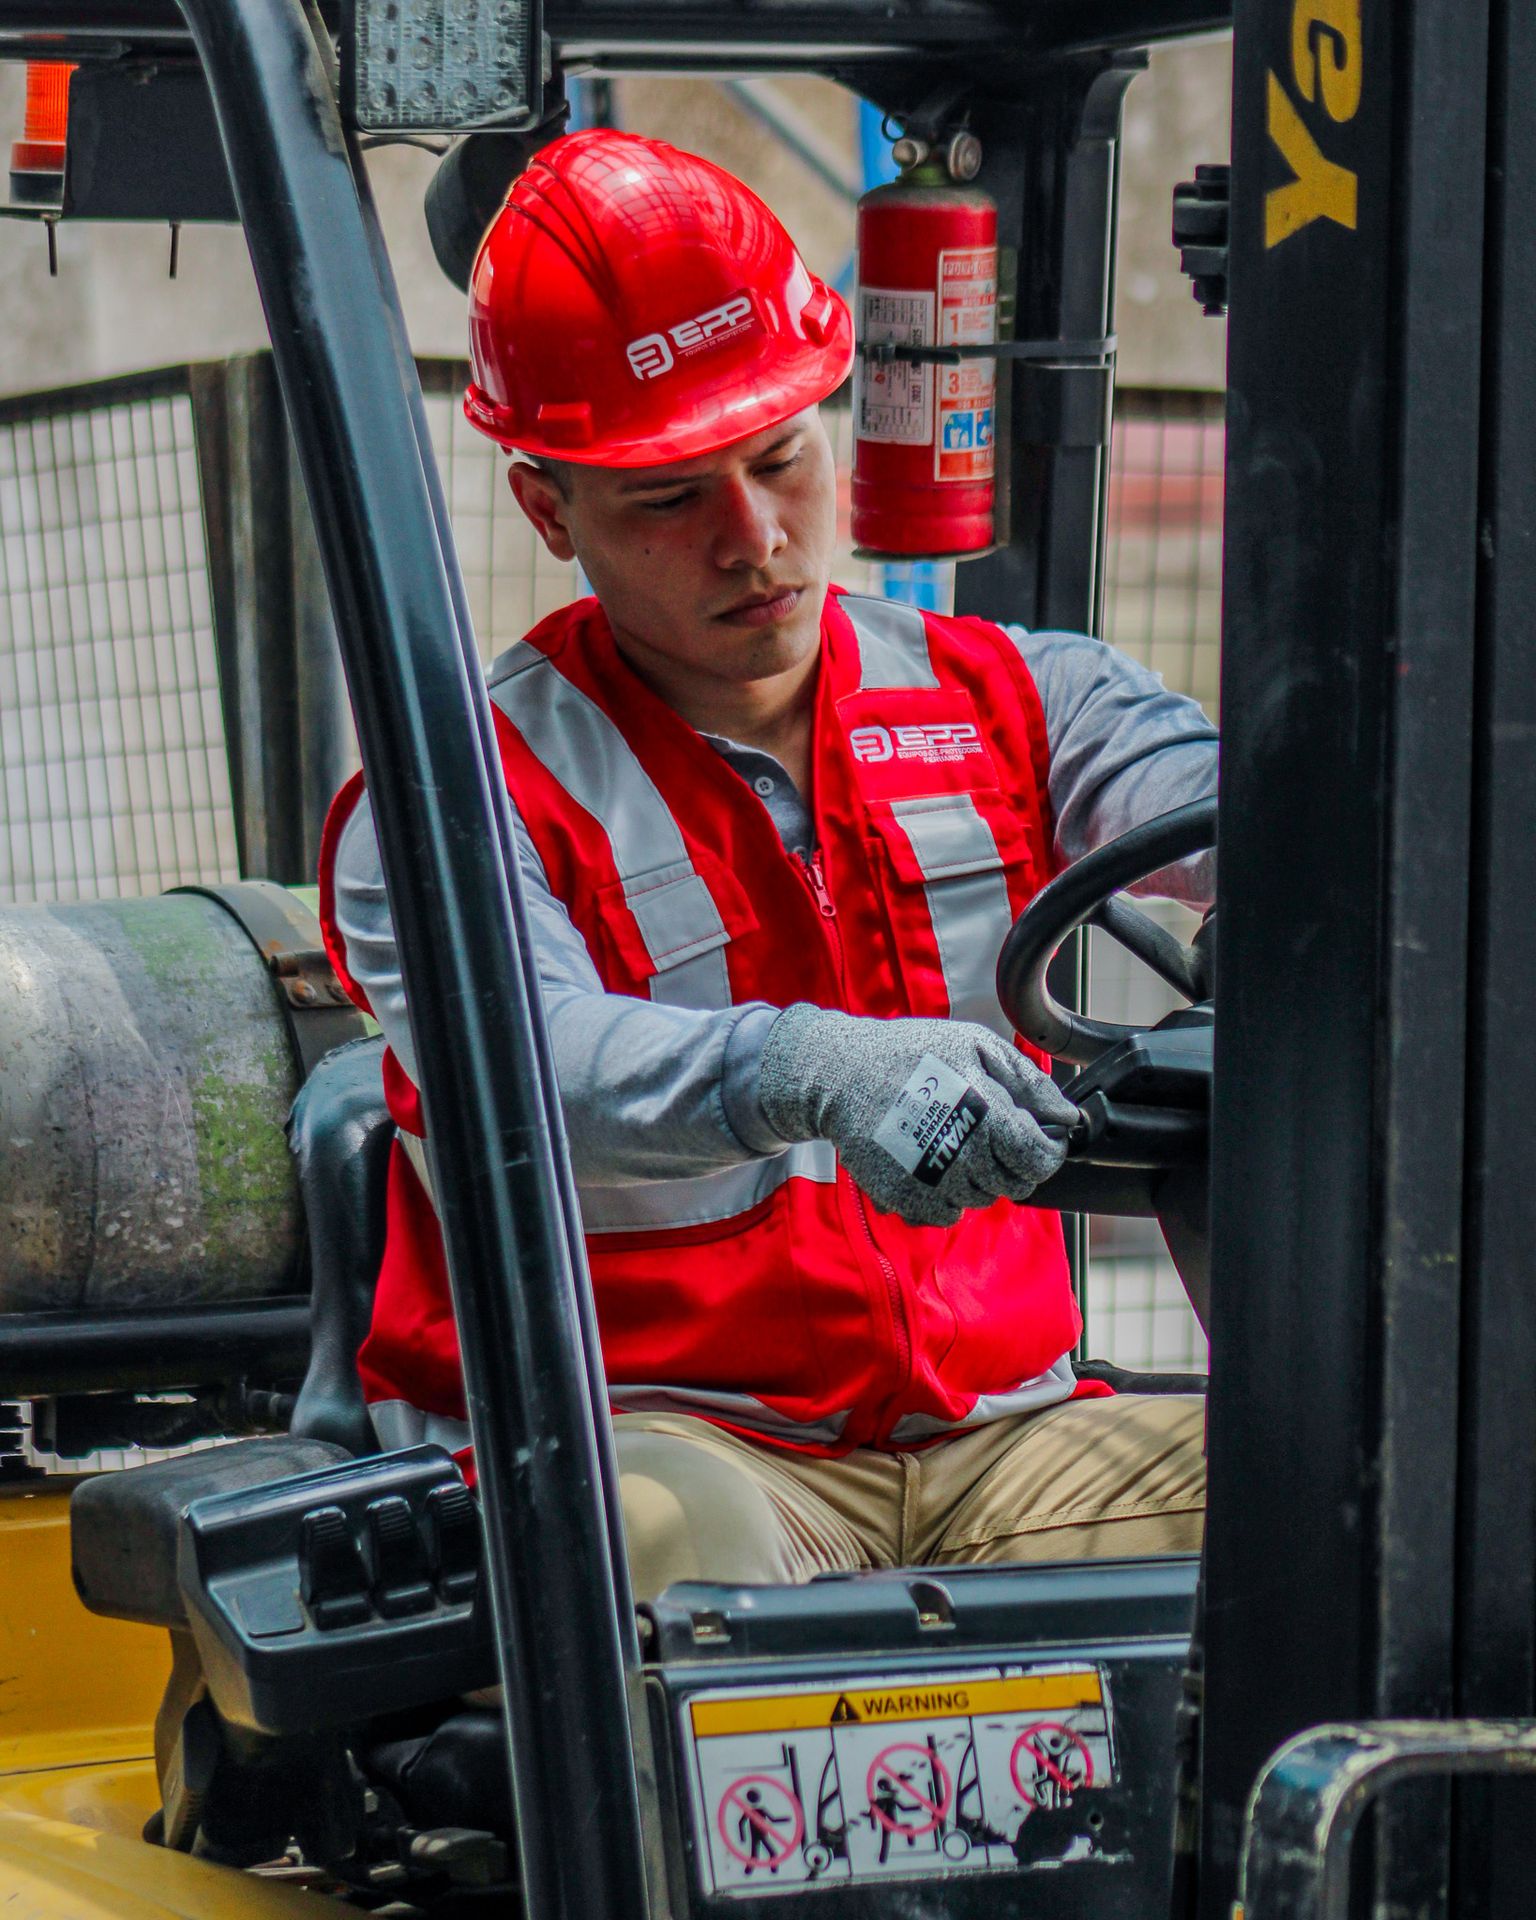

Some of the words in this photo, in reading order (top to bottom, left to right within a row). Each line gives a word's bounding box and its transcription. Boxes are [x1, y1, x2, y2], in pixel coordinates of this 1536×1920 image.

[669, 296, 751, 348] EPP
[890, 723, 977, 746] EPP
[897, 750, 927, 758] EQUIPOS
[912, 1126, 924, 1140] PU
[917, 1103, 951, 1150] SUPERFLEX
[927, 1109, 958, 1155] SAFETY
[928, 1107, 976, 1170] WALL
[863, 1691, 970, 1716] WARNING
